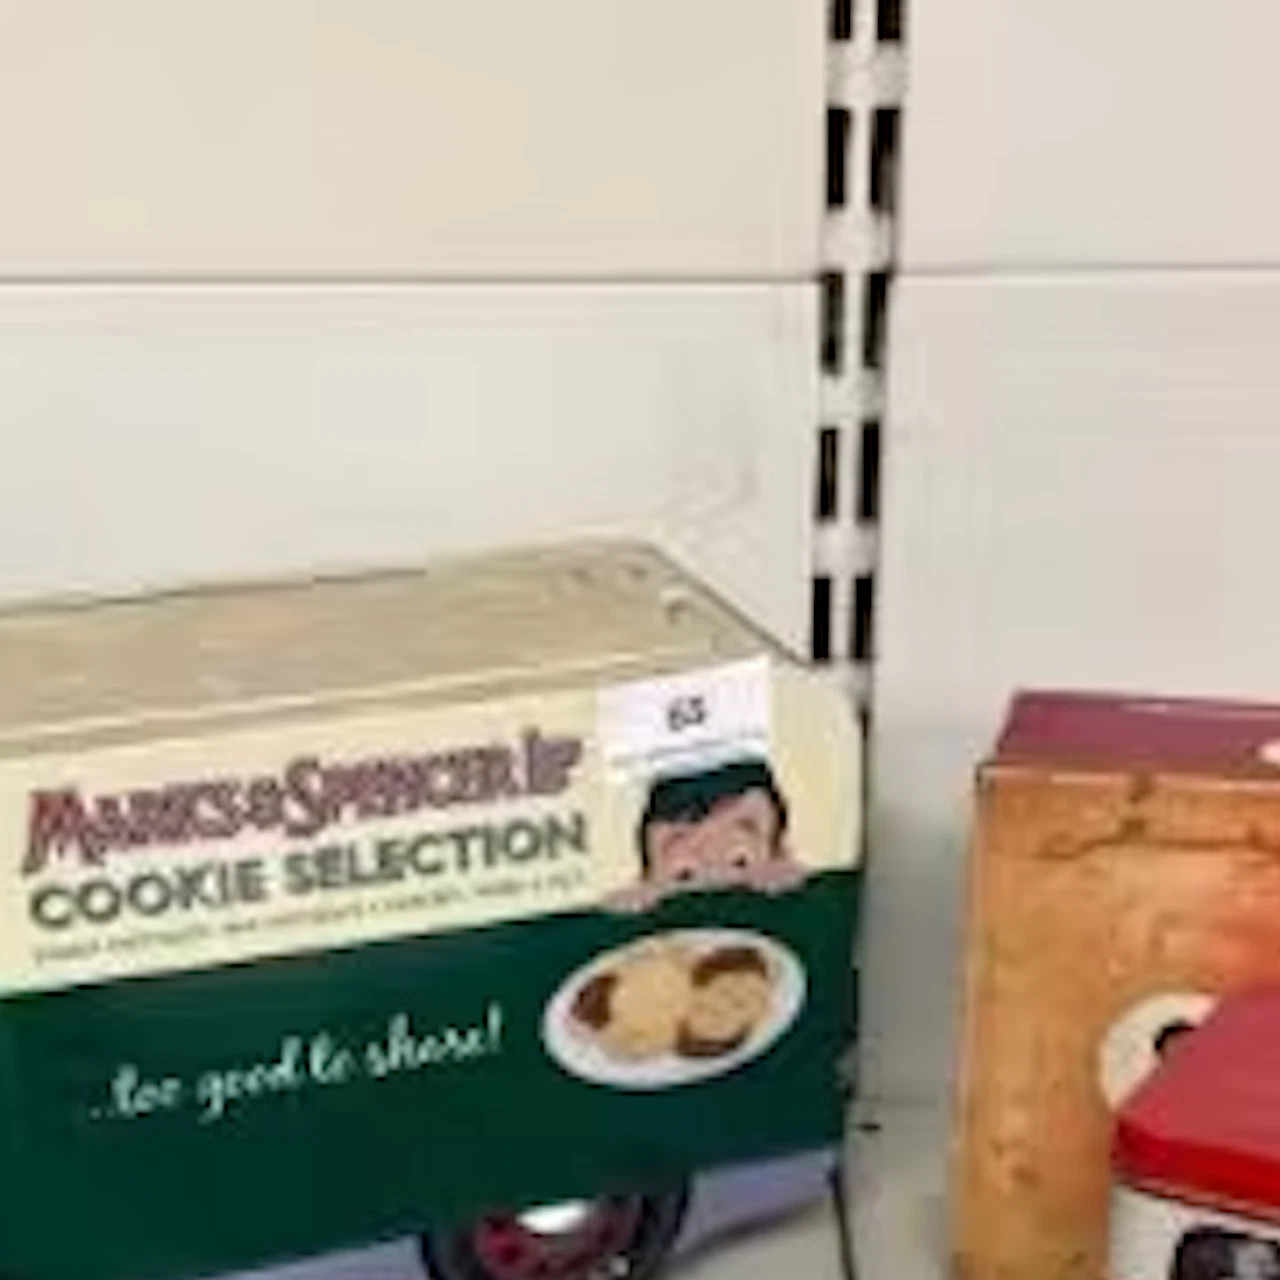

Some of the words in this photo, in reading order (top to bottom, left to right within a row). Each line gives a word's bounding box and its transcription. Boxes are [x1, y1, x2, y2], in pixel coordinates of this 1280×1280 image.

[29, 860, 267, 929] COOKIE
[282, 812, 586, 893] SELECTION
[196, 1034, 302, 1126] good
